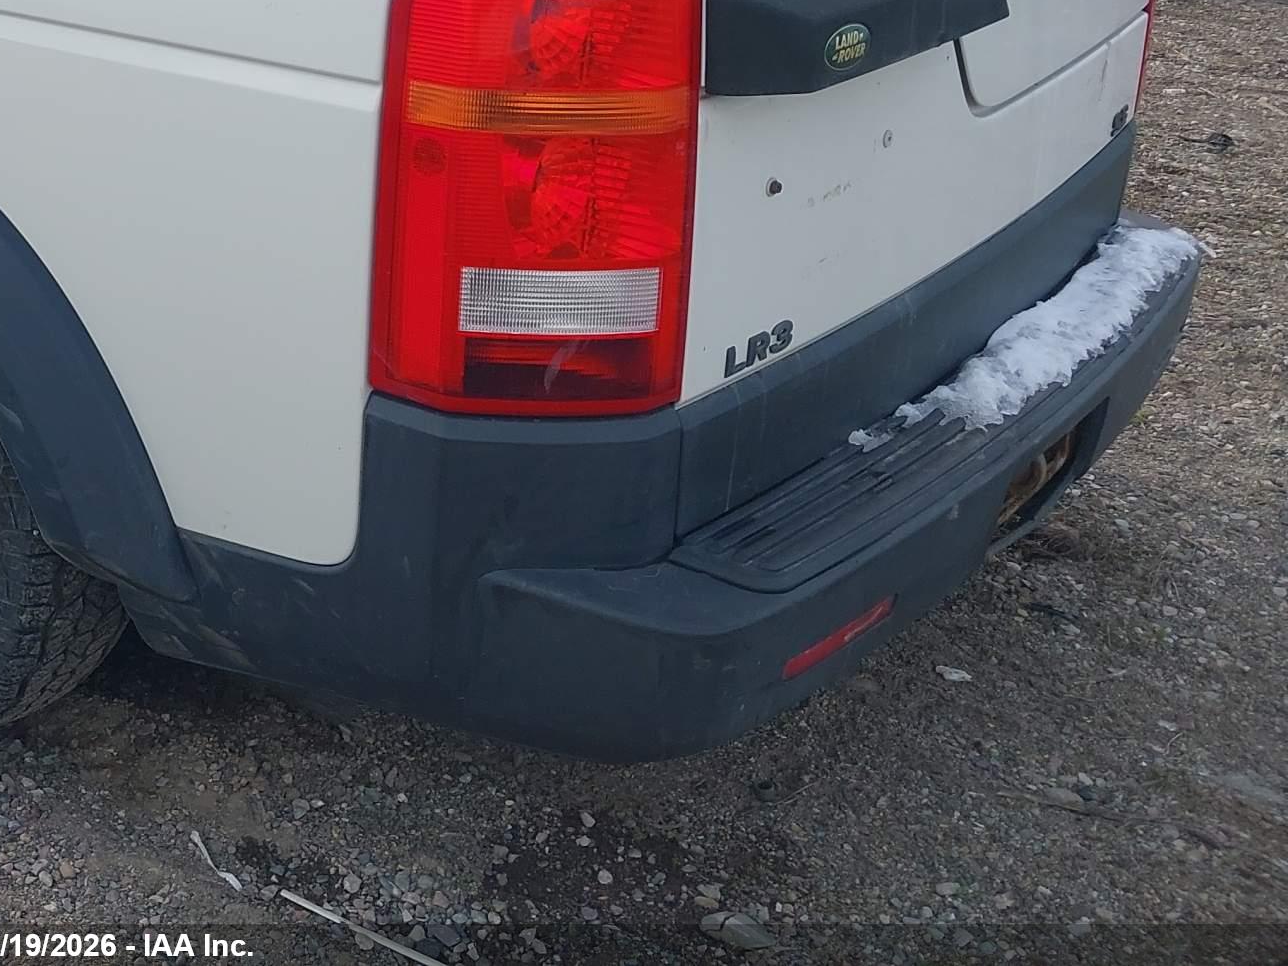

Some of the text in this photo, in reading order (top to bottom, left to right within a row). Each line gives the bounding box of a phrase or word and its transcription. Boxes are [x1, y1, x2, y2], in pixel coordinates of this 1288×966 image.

[835, 30, 859, 50] LAND
[837, 42, 867, 64] ROVER
[723, 319, 794, 379] LR3
